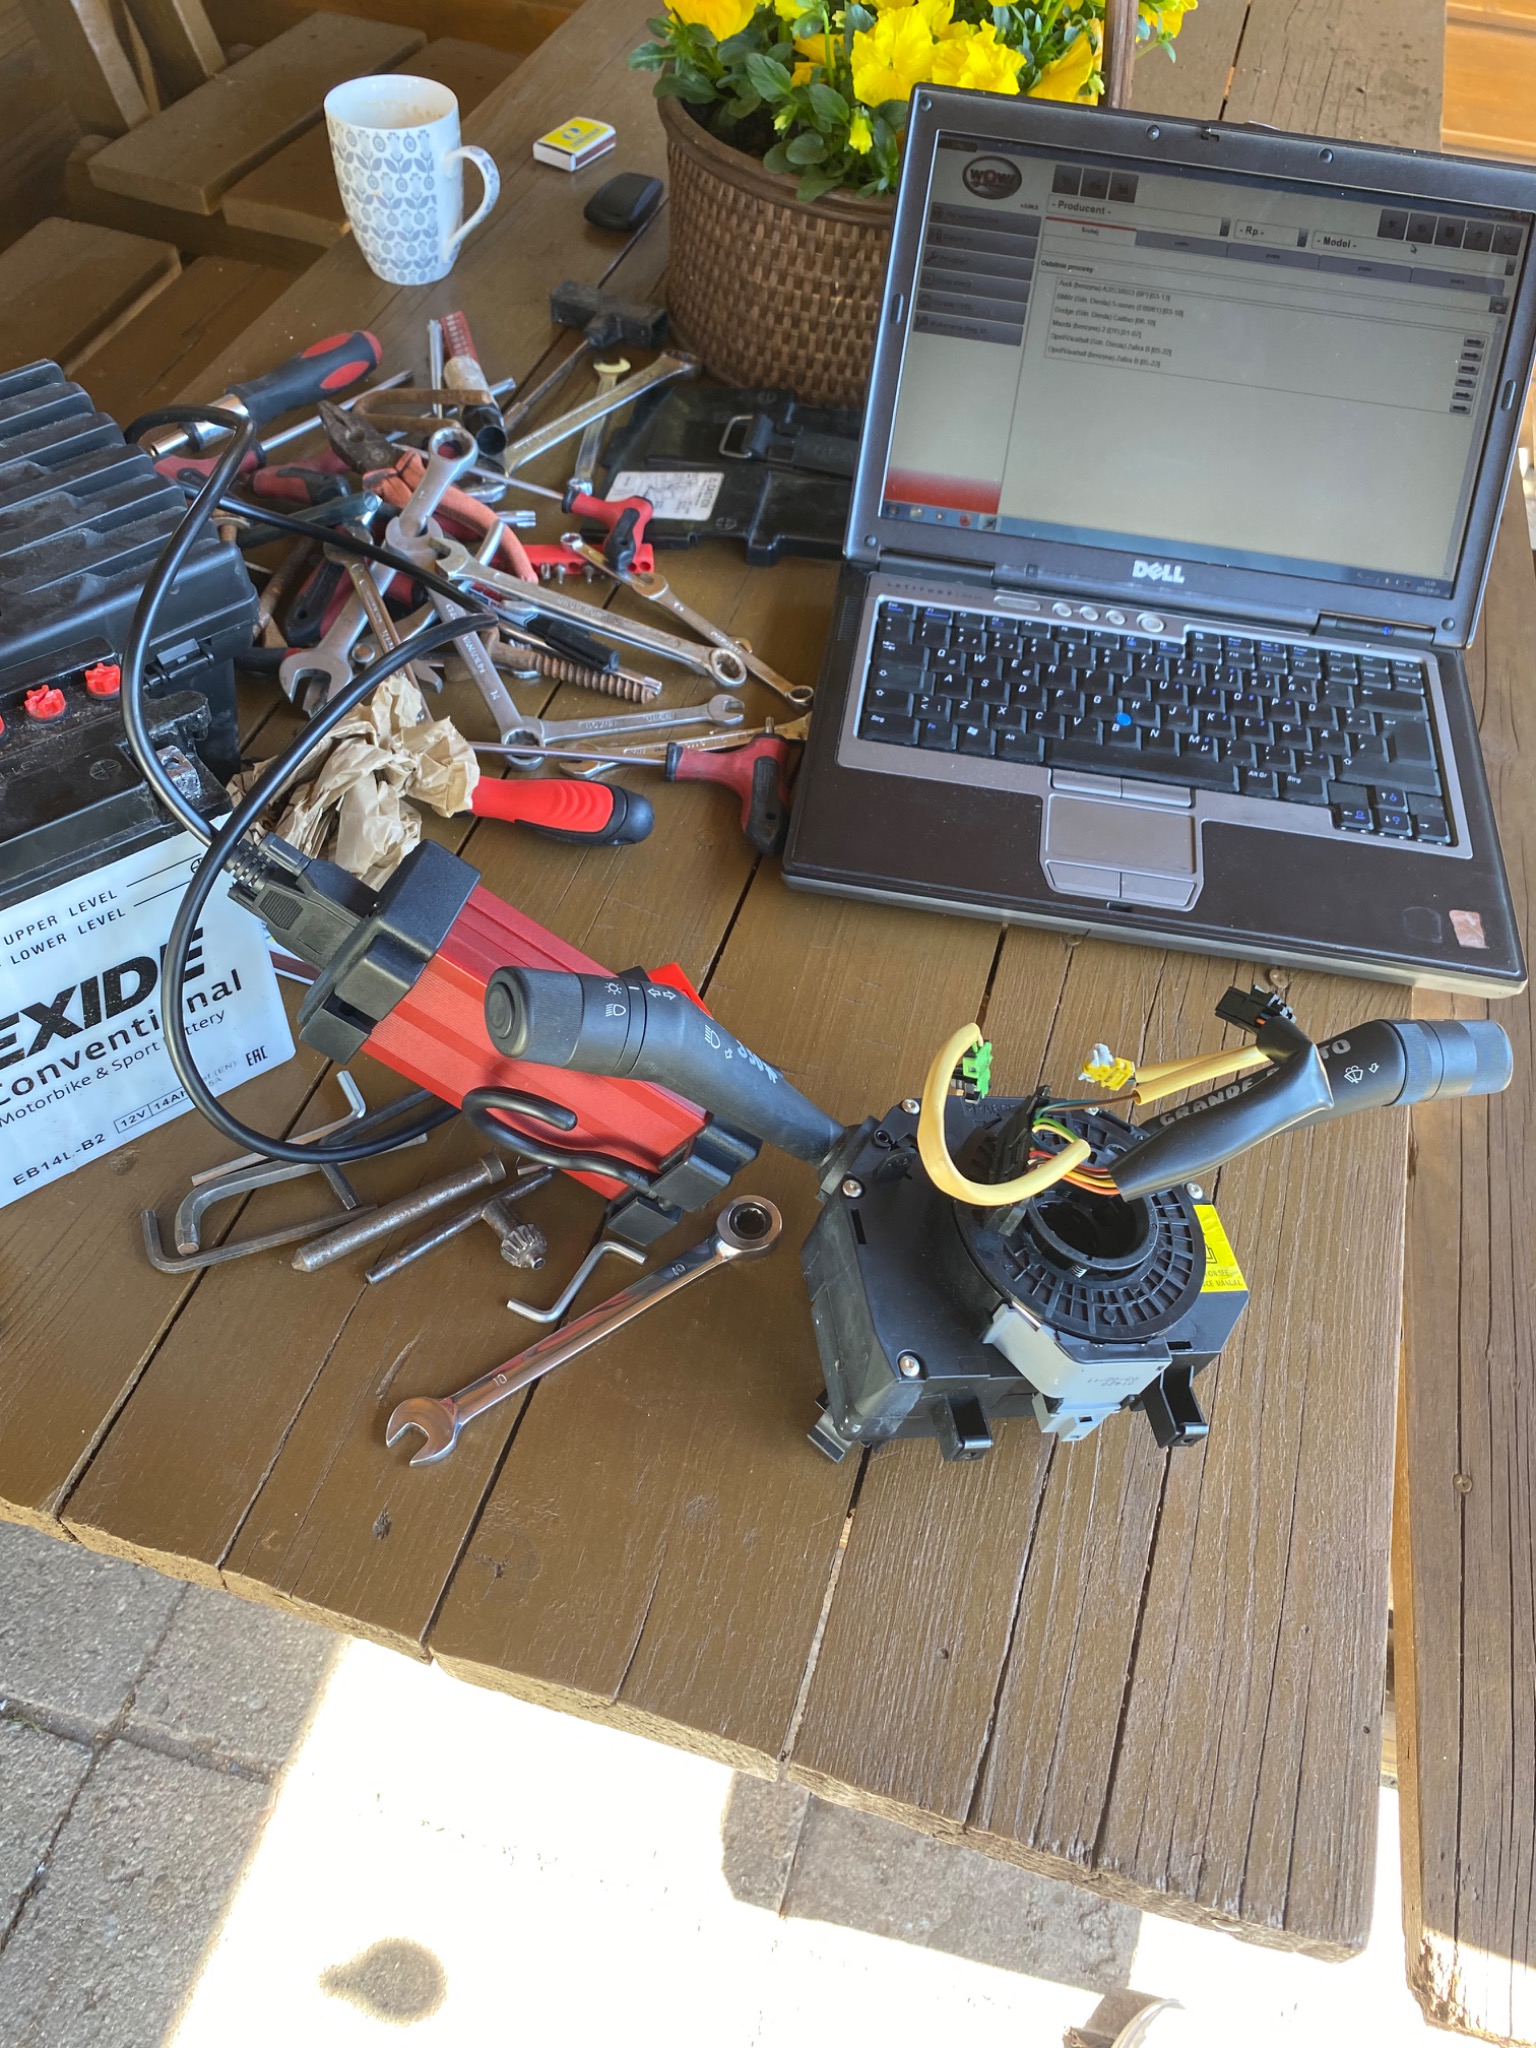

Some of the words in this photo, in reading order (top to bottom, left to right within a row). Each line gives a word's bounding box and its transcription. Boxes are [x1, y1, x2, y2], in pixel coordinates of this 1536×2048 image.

[1057, 199, 1105, 215] Producent
[1245, 226, 1259, 237] Rp
[1323, 236, 1351, 249] Model
[1132, 559, 1185, 584] DELL
[974, 653, 986, 663] W
[1011, 659, 1019, 668] E
[1048, 664, 1057, 674] R
[943, 674, 953, 683] A
[1085, 670, 1093, 679] T
[980, 679, 990, 688] S
[1159, 681, 1168, 690] U
[1018, 684, 1028, 693] D
[1055, 689, 1065, 698] F
[1093, 695, 1102, 704] G
[1271, 697, 1280, 706] P
[959, 701, 969, 710] Z
[1131, 701, 1141, 710] H
[997, 706, 1008, 715] X
[1168, 706, 1178, 715] J
[1035, 711, 1044, 720] C
[1206, 712, 1216, 722] K
[1073, 717, 1082, 726] V
[1244, 717, 1251, 727] L
[1111, 723, 1121, 732] B
[1149, 728, 1160, 738] N
[1188, 734, 1200, 744] M
[3, 914, 58, 946] UPPER
[68, 890, 118, 917] LEVEL
[10, 933, 67, 965] LOWER
[77, 908, 126, 935] LEVEL
[0, 1077, 92, 1128] Motorbike
[95, 1067, 109, 1079] &
[111, 1041, 161, 1073] Sport
[184, 1010, 225, 1037] ttery
[120, 1109, 146, 1128] 12V
[493, 1373, 508, 1387] 10
